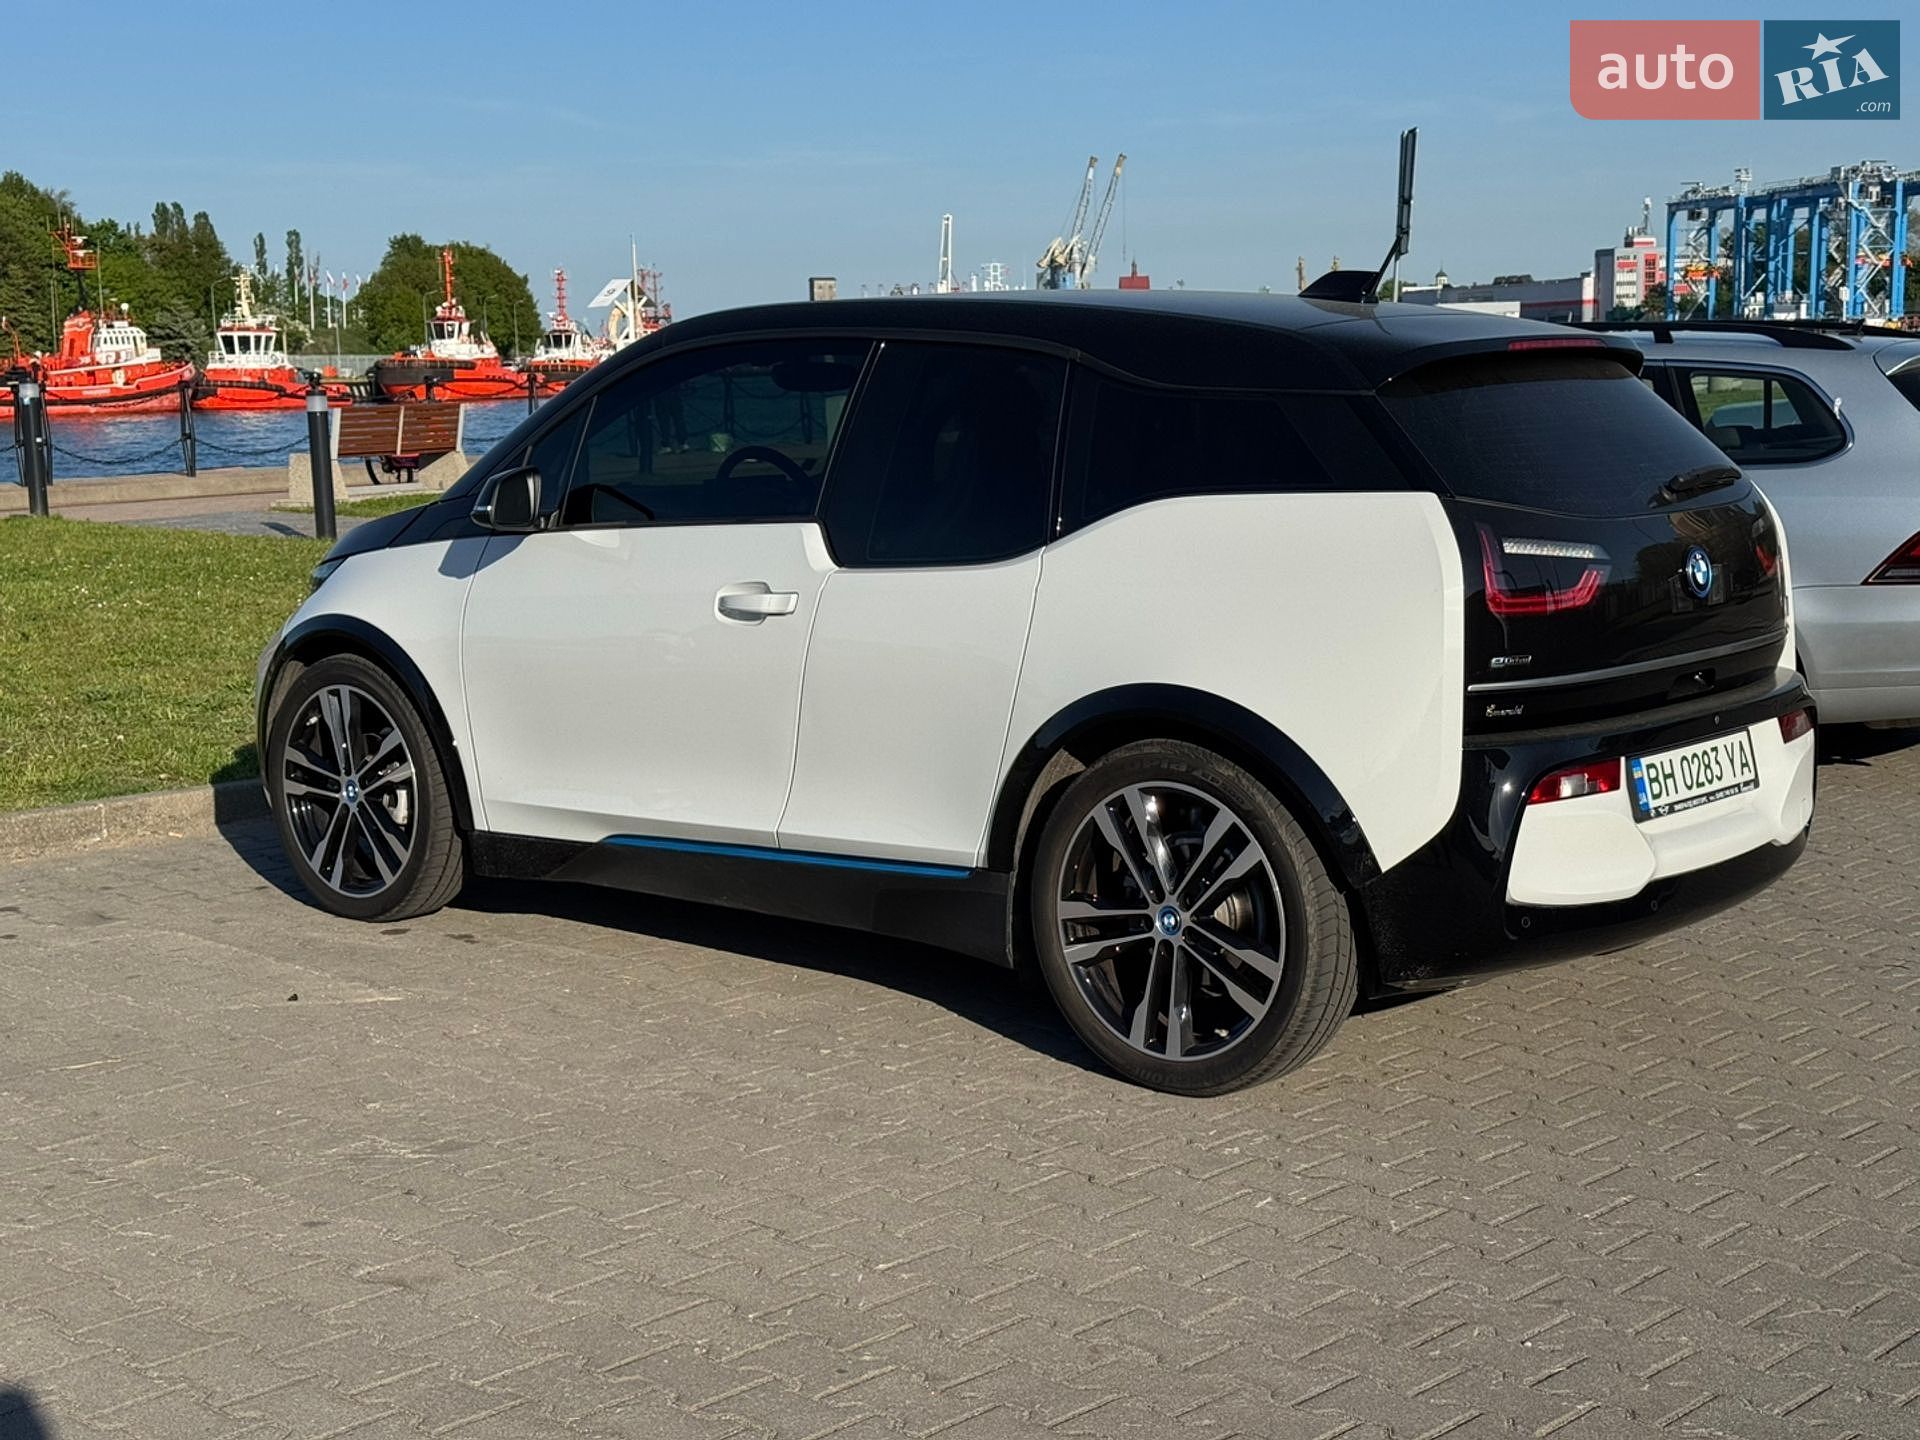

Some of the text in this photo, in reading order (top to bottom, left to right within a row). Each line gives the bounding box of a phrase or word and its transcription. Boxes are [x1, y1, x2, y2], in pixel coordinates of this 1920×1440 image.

[1646, 758, 1679, 800] BH
[1680, 746, 1723, 791] 0283
[1724, 740, 1752, 778] YA
